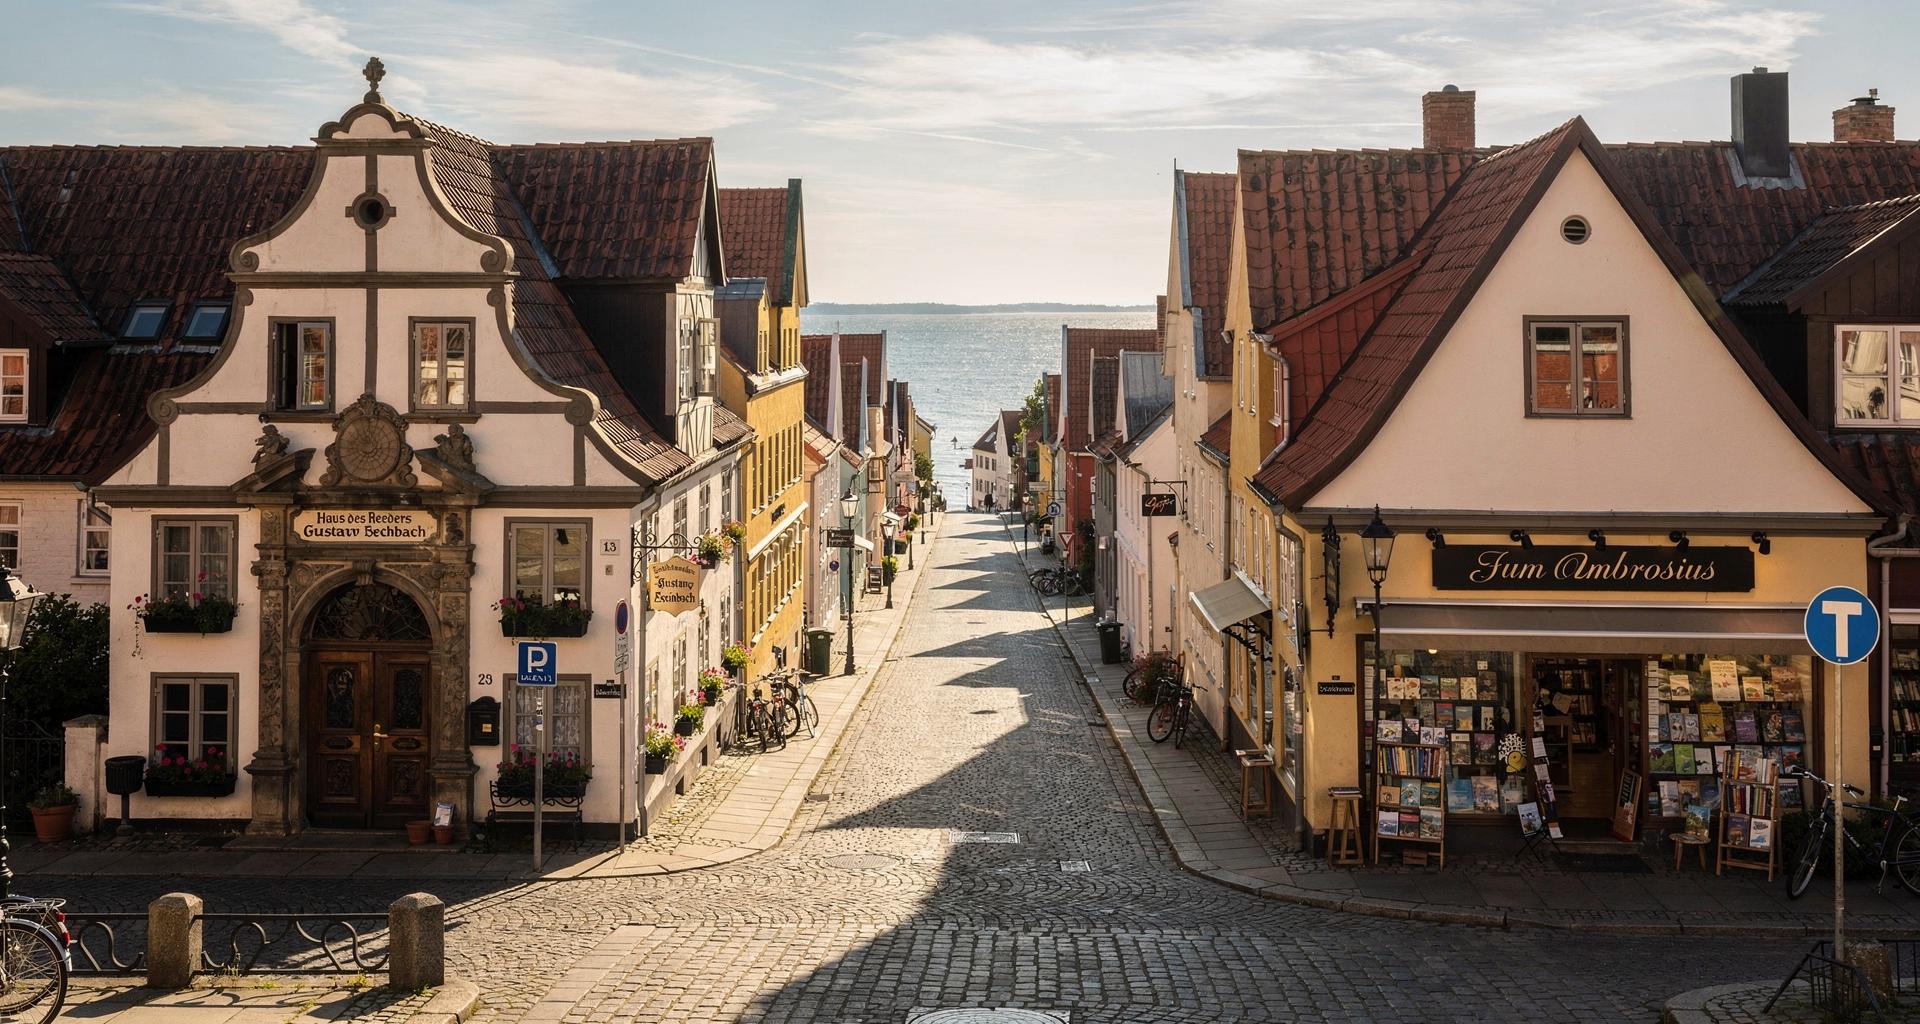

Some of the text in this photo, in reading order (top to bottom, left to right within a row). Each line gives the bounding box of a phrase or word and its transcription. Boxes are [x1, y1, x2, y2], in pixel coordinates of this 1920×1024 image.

[316, 511, 412, 524] Haus des Reeders
[603, 541, 617, 552] 13
[1554, 550, 1716, 581] Ambrosius
[1822, 600, 1862, 658] T
[527, 646, 549, 673] P
